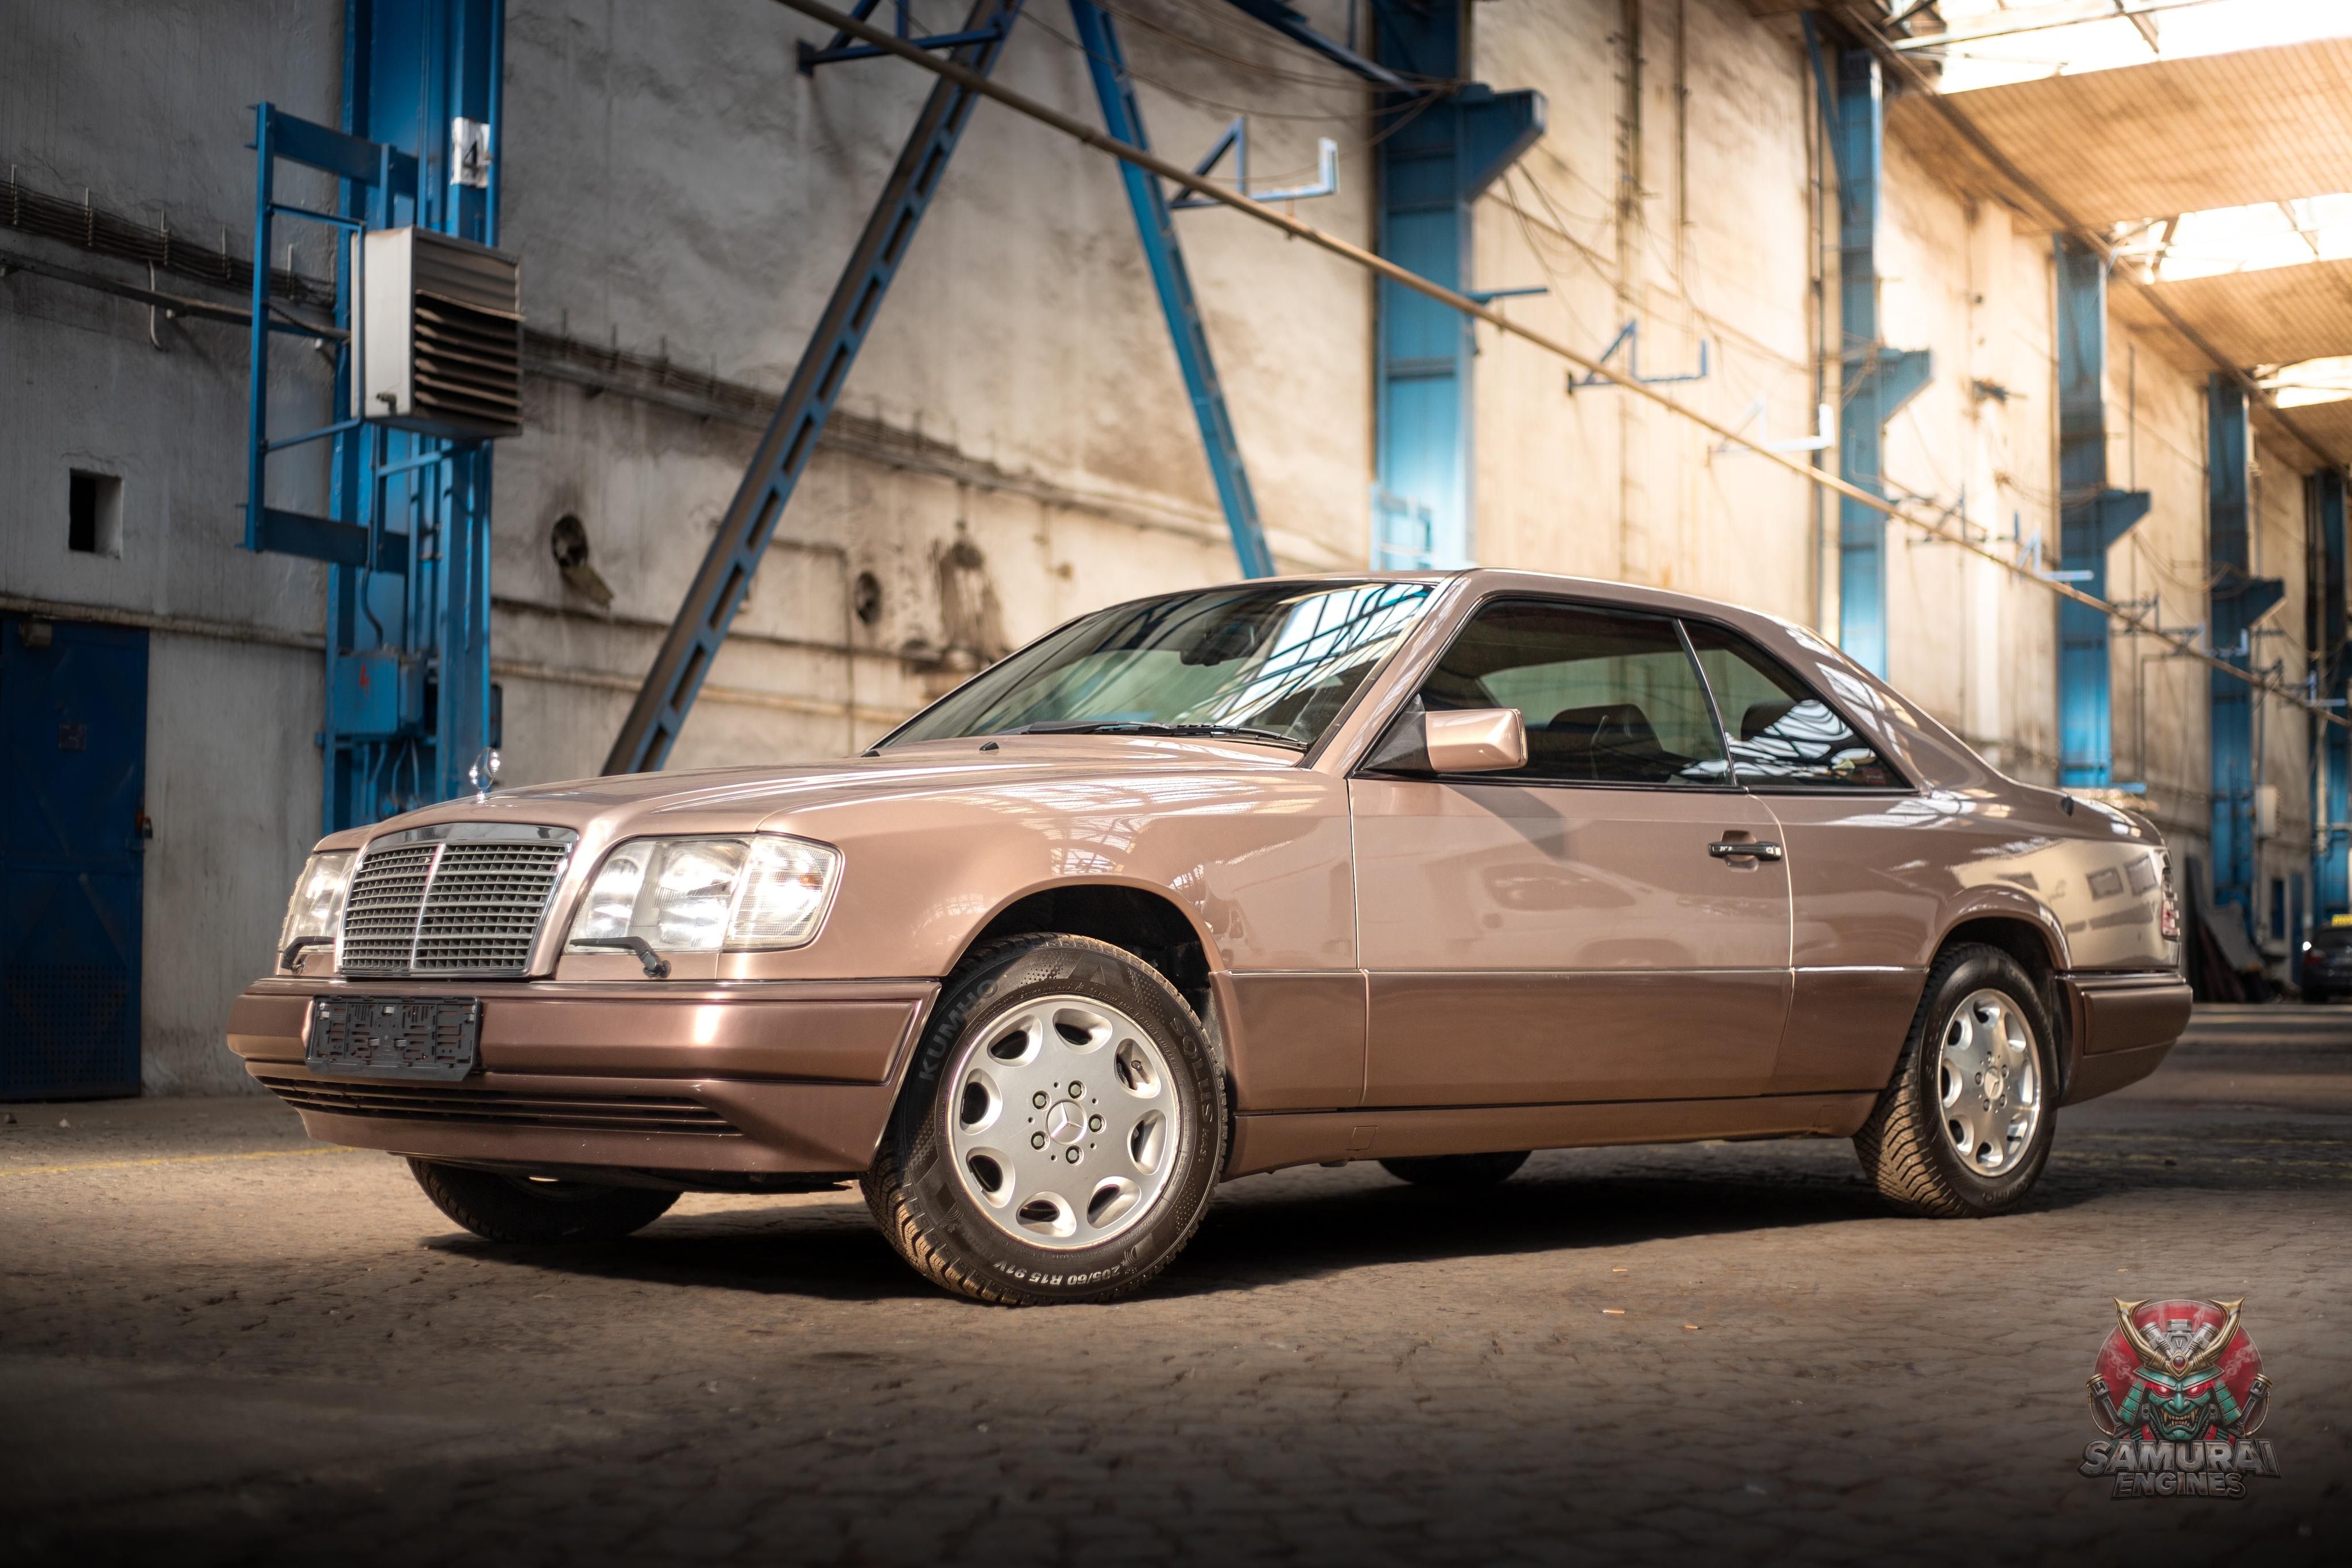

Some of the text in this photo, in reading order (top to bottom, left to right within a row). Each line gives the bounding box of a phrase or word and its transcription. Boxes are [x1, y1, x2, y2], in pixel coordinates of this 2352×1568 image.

[462, 141, 481, 179] 4
[918, 979, 999, 1081] KUMHO
[993, 1260, 1120, 1286] 205/60 R15 91V
